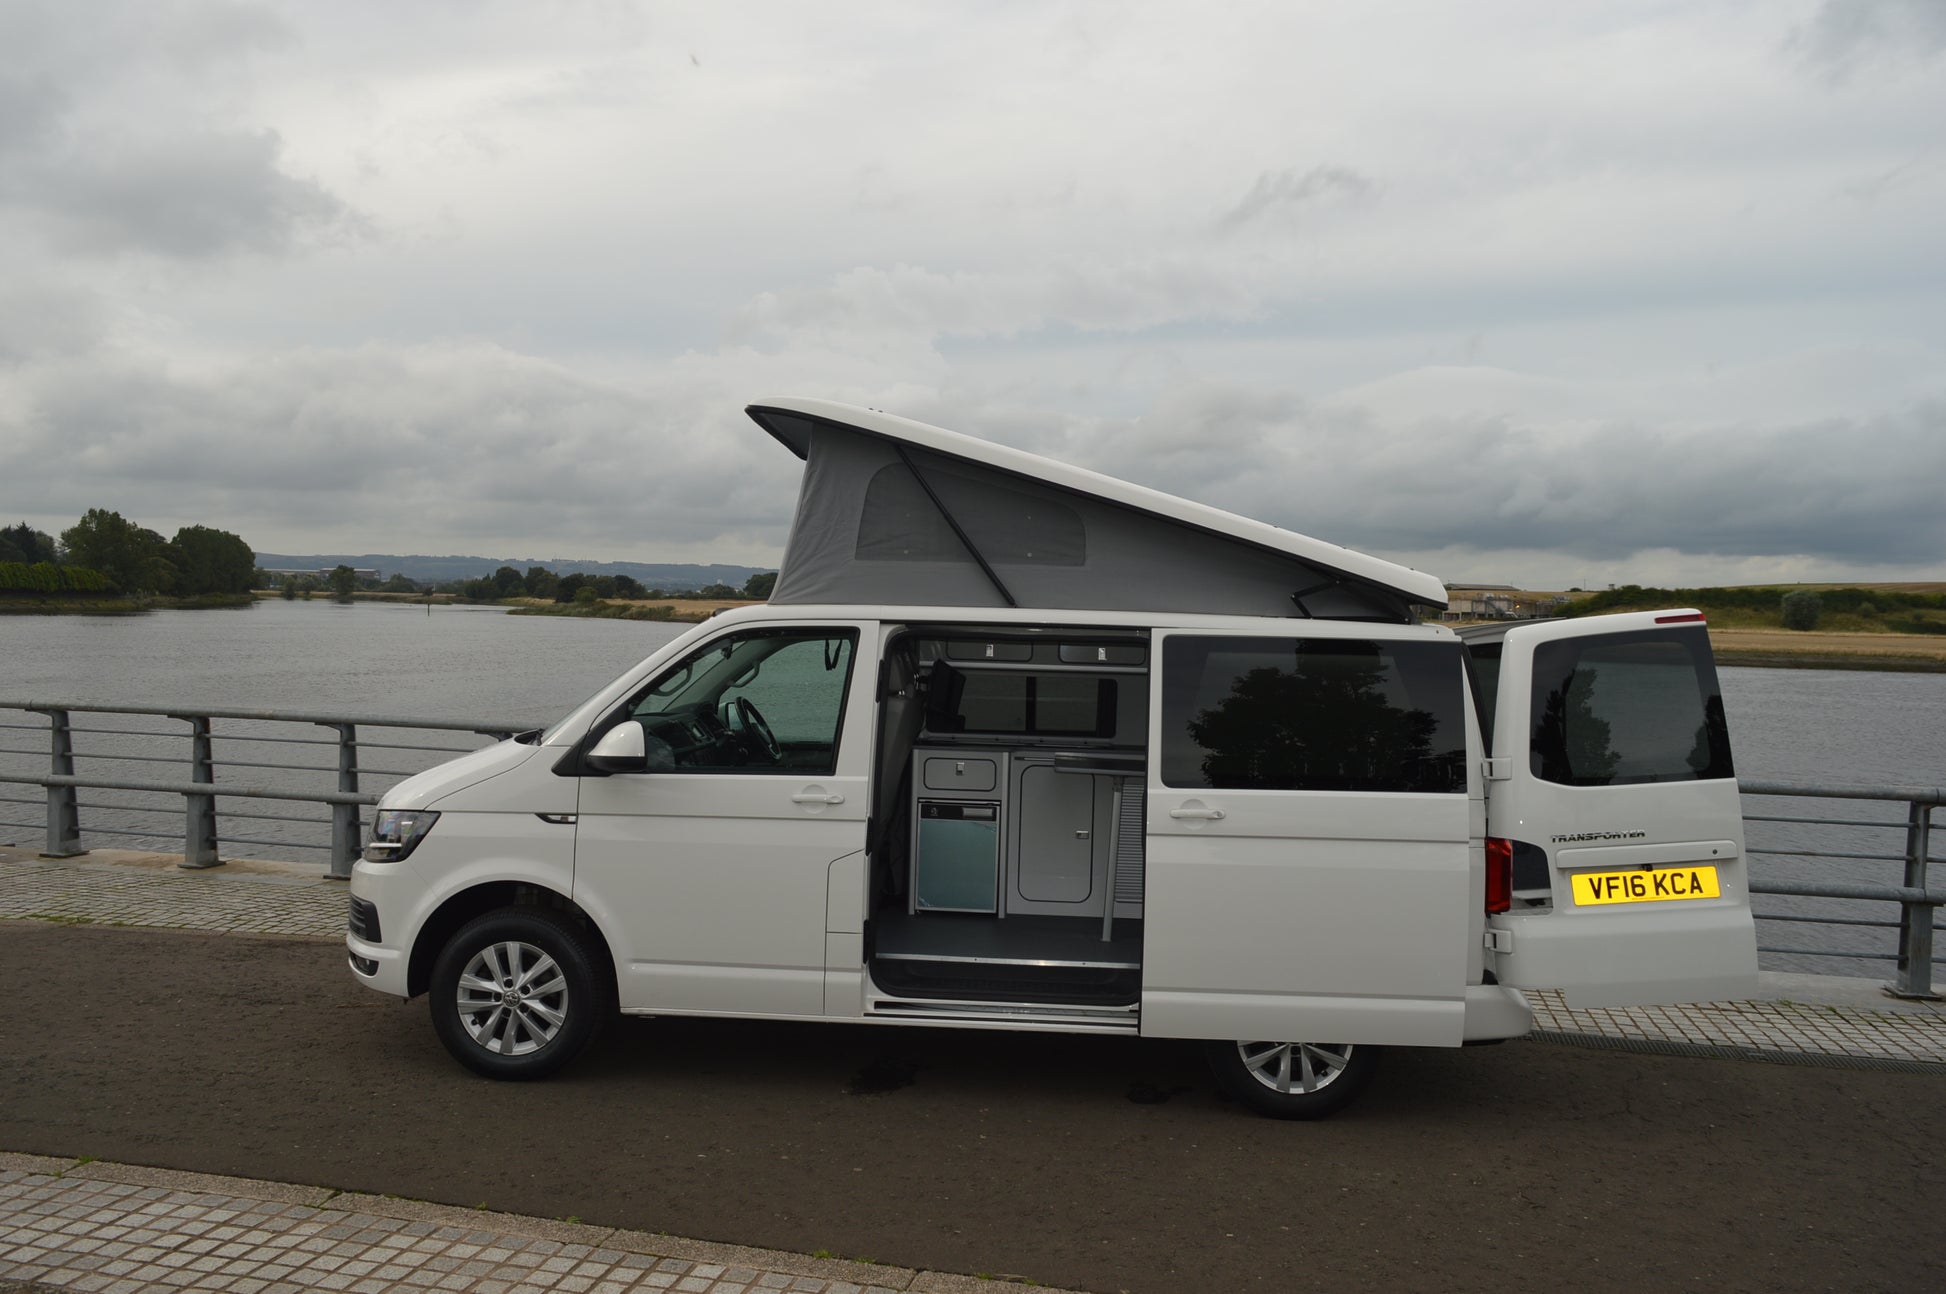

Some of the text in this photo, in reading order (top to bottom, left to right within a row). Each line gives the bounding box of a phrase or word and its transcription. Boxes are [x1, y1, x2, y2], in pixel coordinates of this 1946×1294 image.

[1551, 829, 1646, 843] TRANSPORTER
[1588, 872, 1704, 900] VF16 KCA
